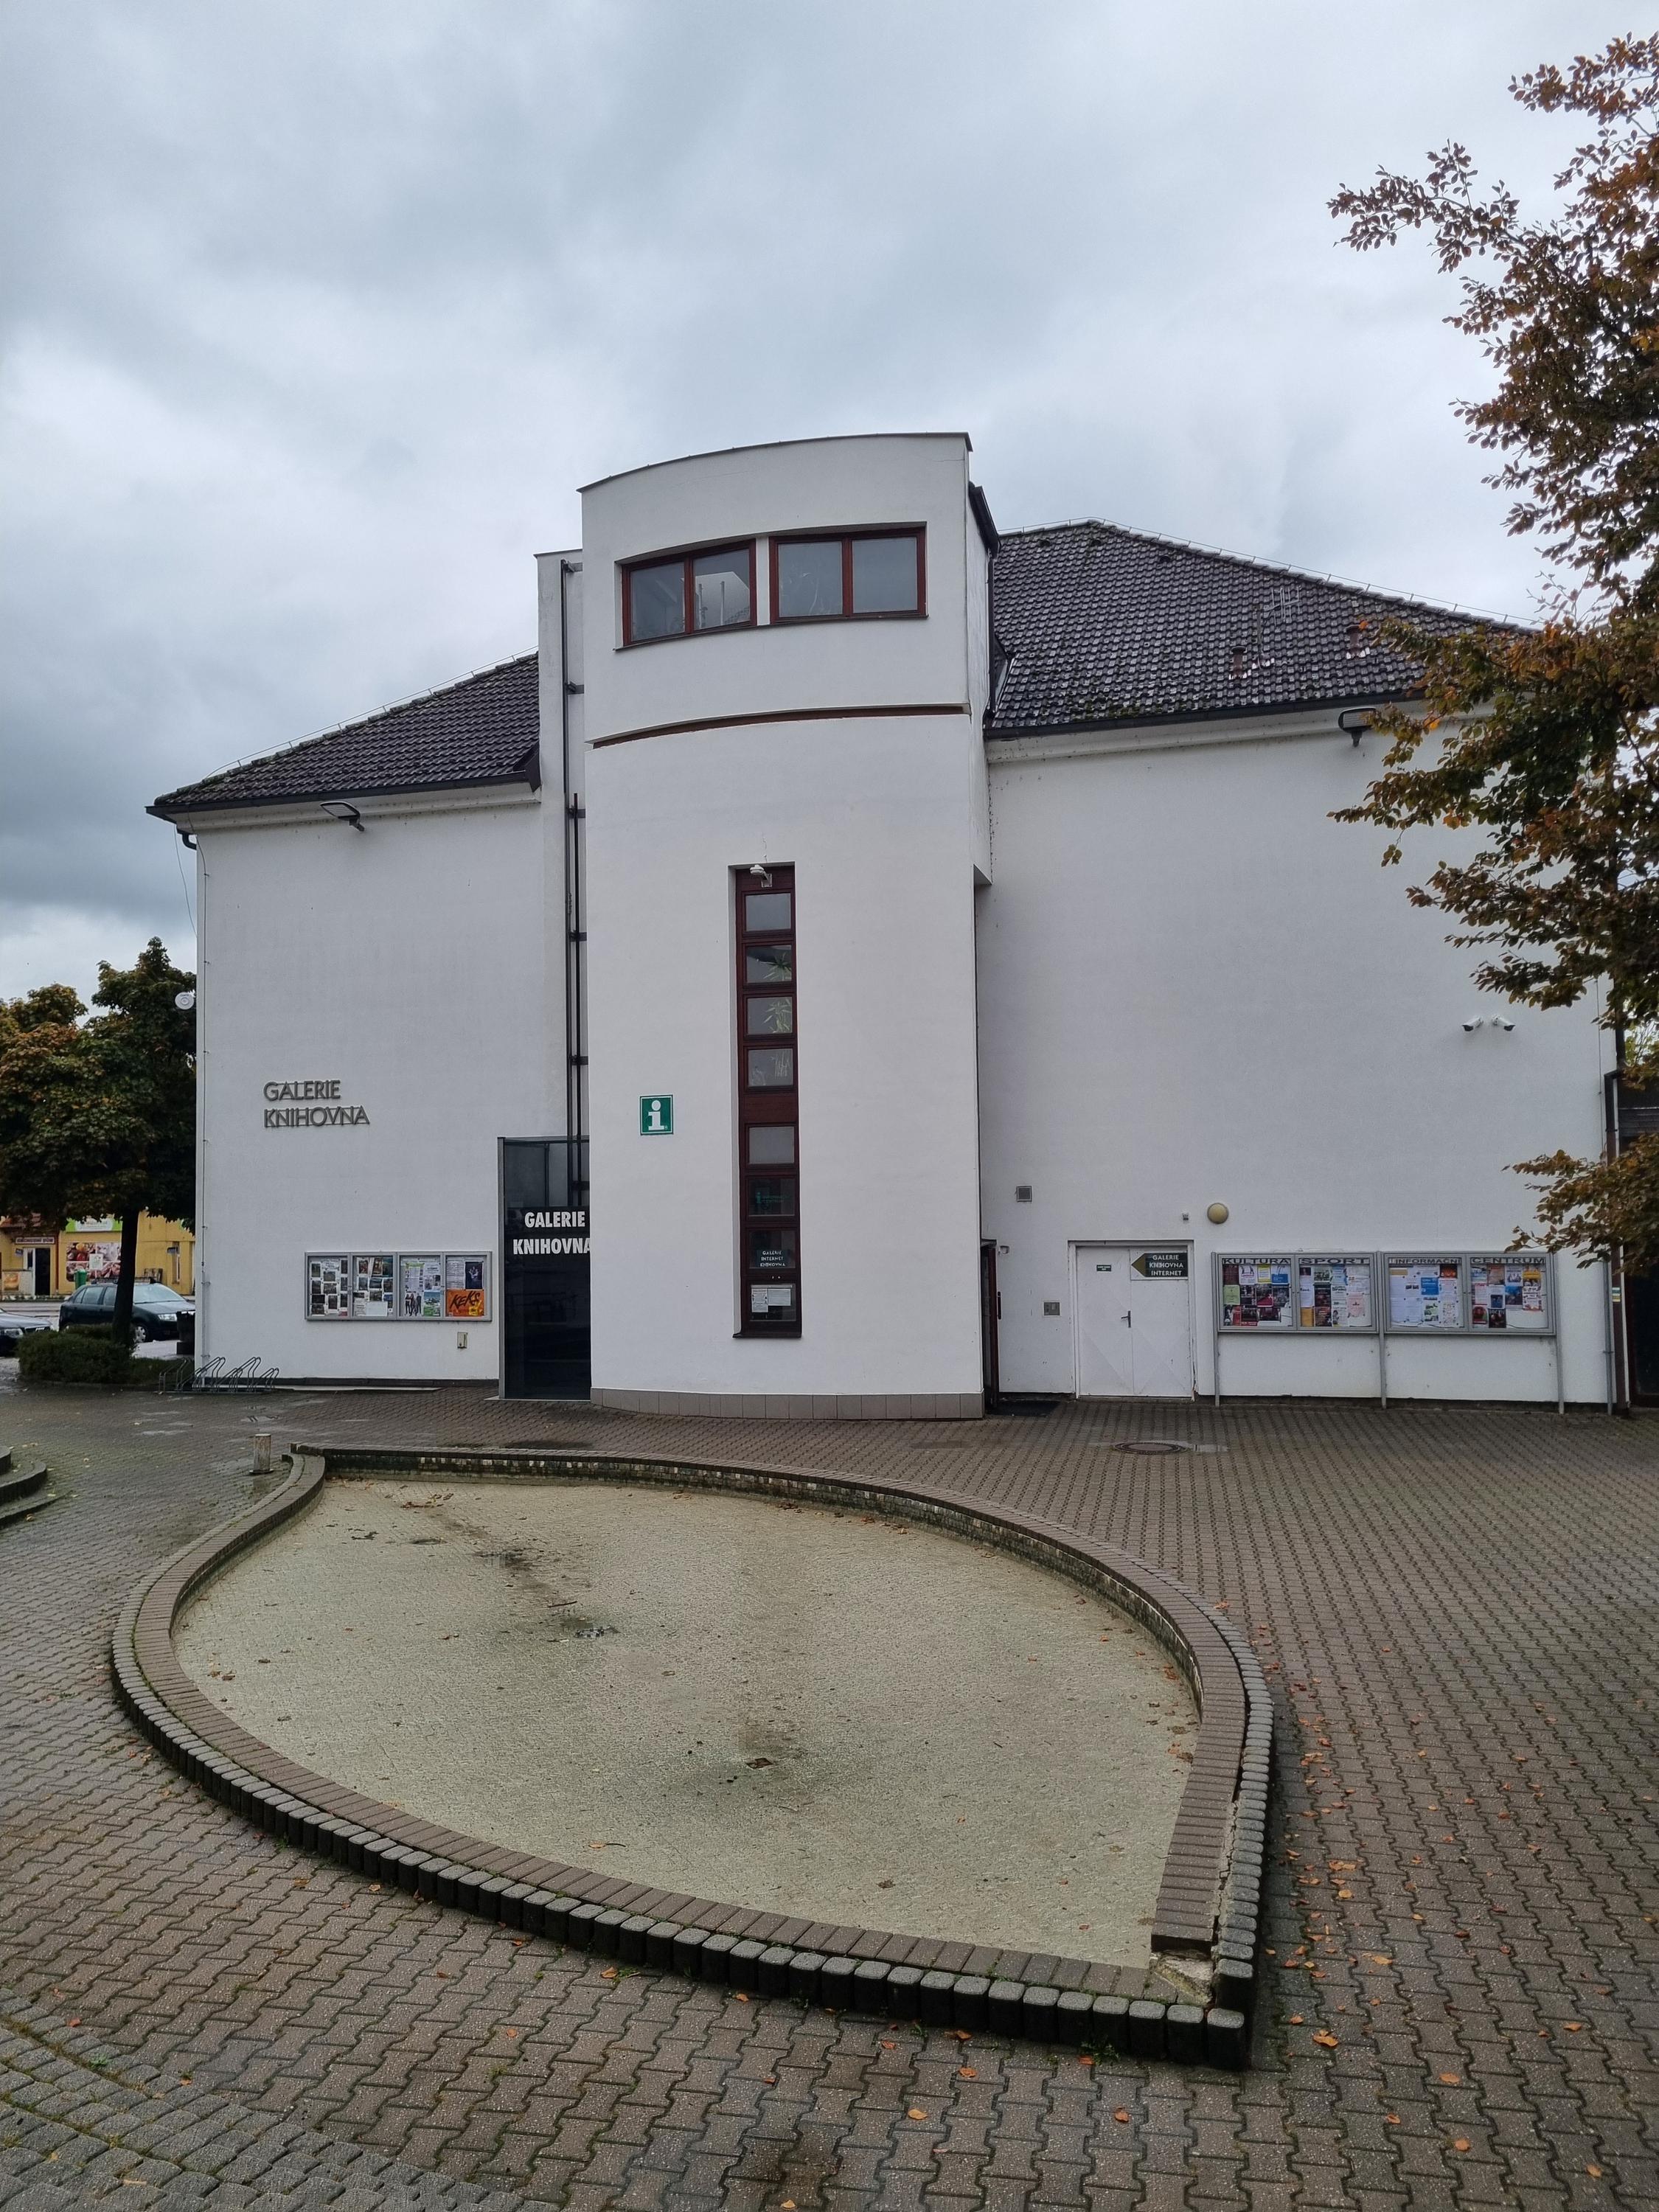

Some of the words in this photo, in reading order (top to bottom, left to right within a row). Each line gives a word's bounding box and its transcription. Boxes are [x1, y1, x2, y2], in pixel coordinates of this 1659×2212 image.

[263, 1079, 341, 1101] GALERIE
[264, 1105, 370, 1128] KNIHOVNA
[524, 1211, 585, 1228] GALERIE
[513, 1238, 590, 1254] KNIHOVNA
